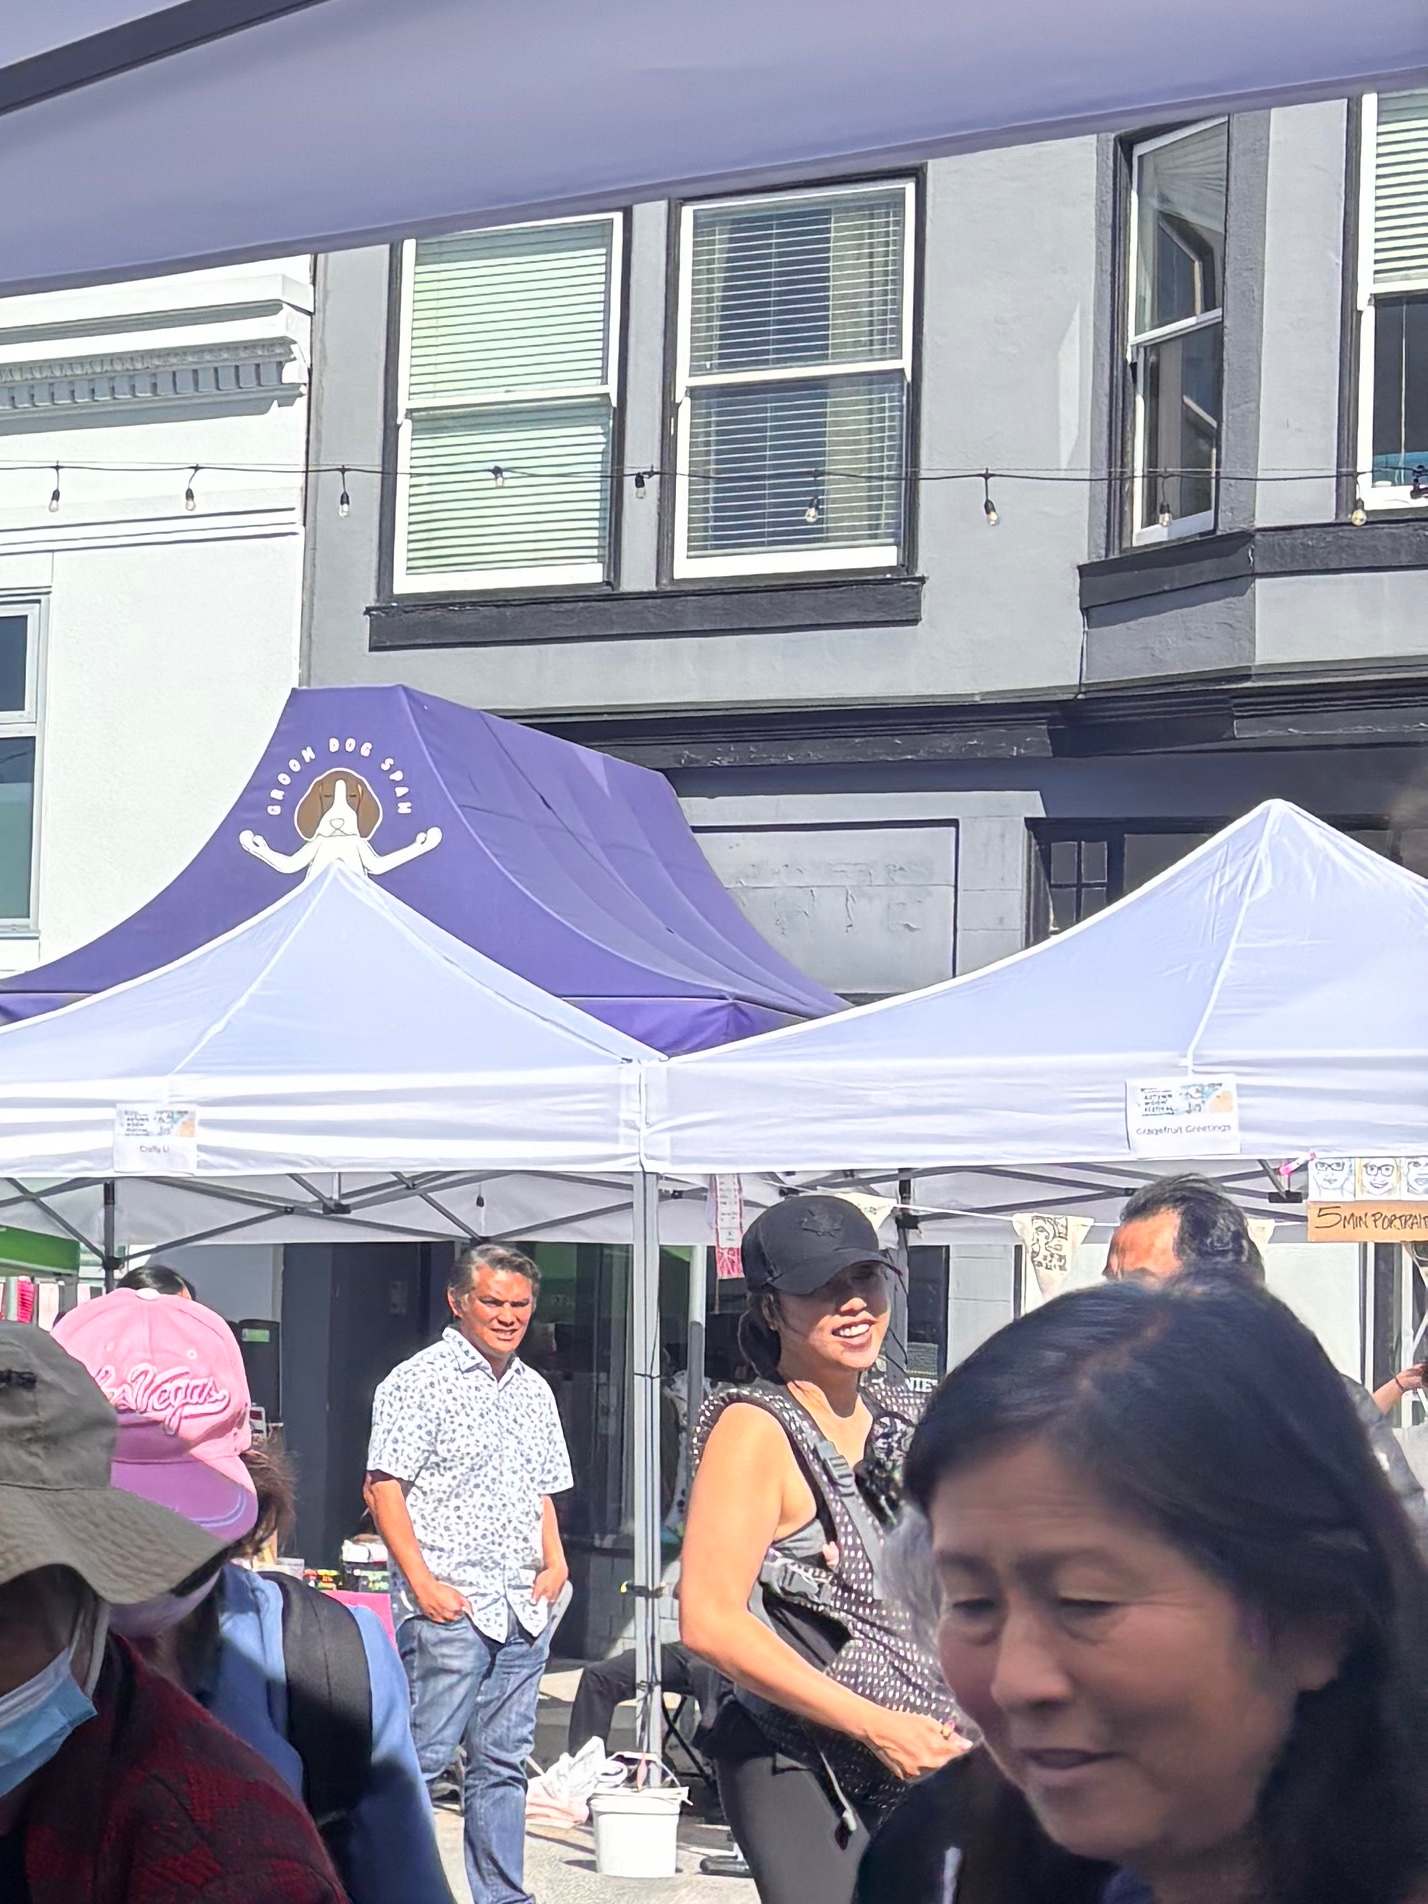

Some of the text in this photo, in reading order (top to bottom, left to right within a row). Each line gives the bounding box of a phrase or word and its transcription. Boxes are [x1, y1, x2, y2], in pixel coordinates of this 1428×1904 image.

[329, 737, 373, 757] DOG
[1314, 1205, 1342, 1229] 5
[1342, 1212, 1368, 1229] MIN
